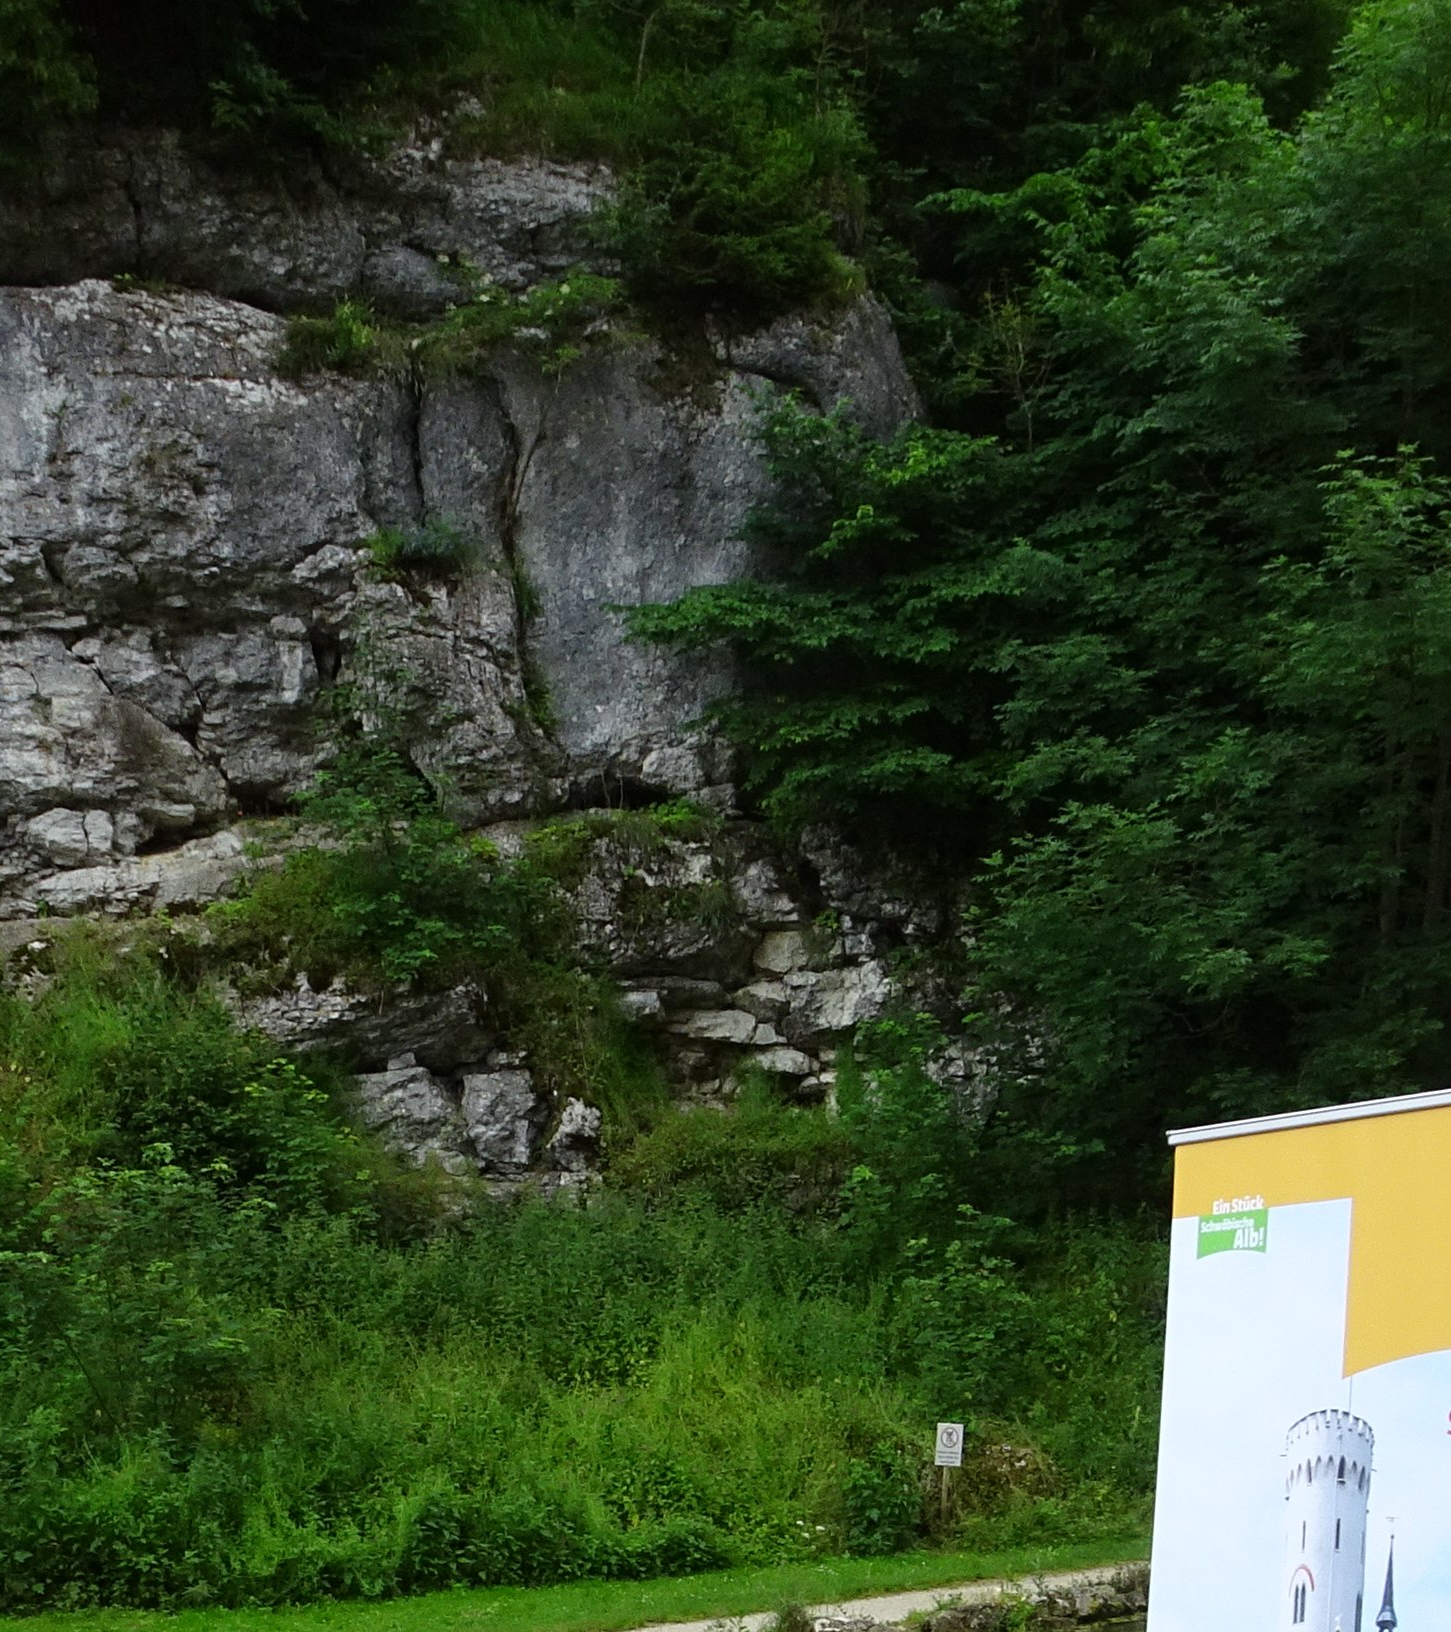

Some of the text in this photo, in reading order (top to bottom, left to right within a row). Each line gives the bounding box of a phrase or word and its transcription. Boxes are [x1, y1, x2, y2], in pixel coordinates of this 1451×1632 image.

[1213, 1195, 1264, 1215] Ein Stück
[1233, 1229, 1265, 1250] Alb!
